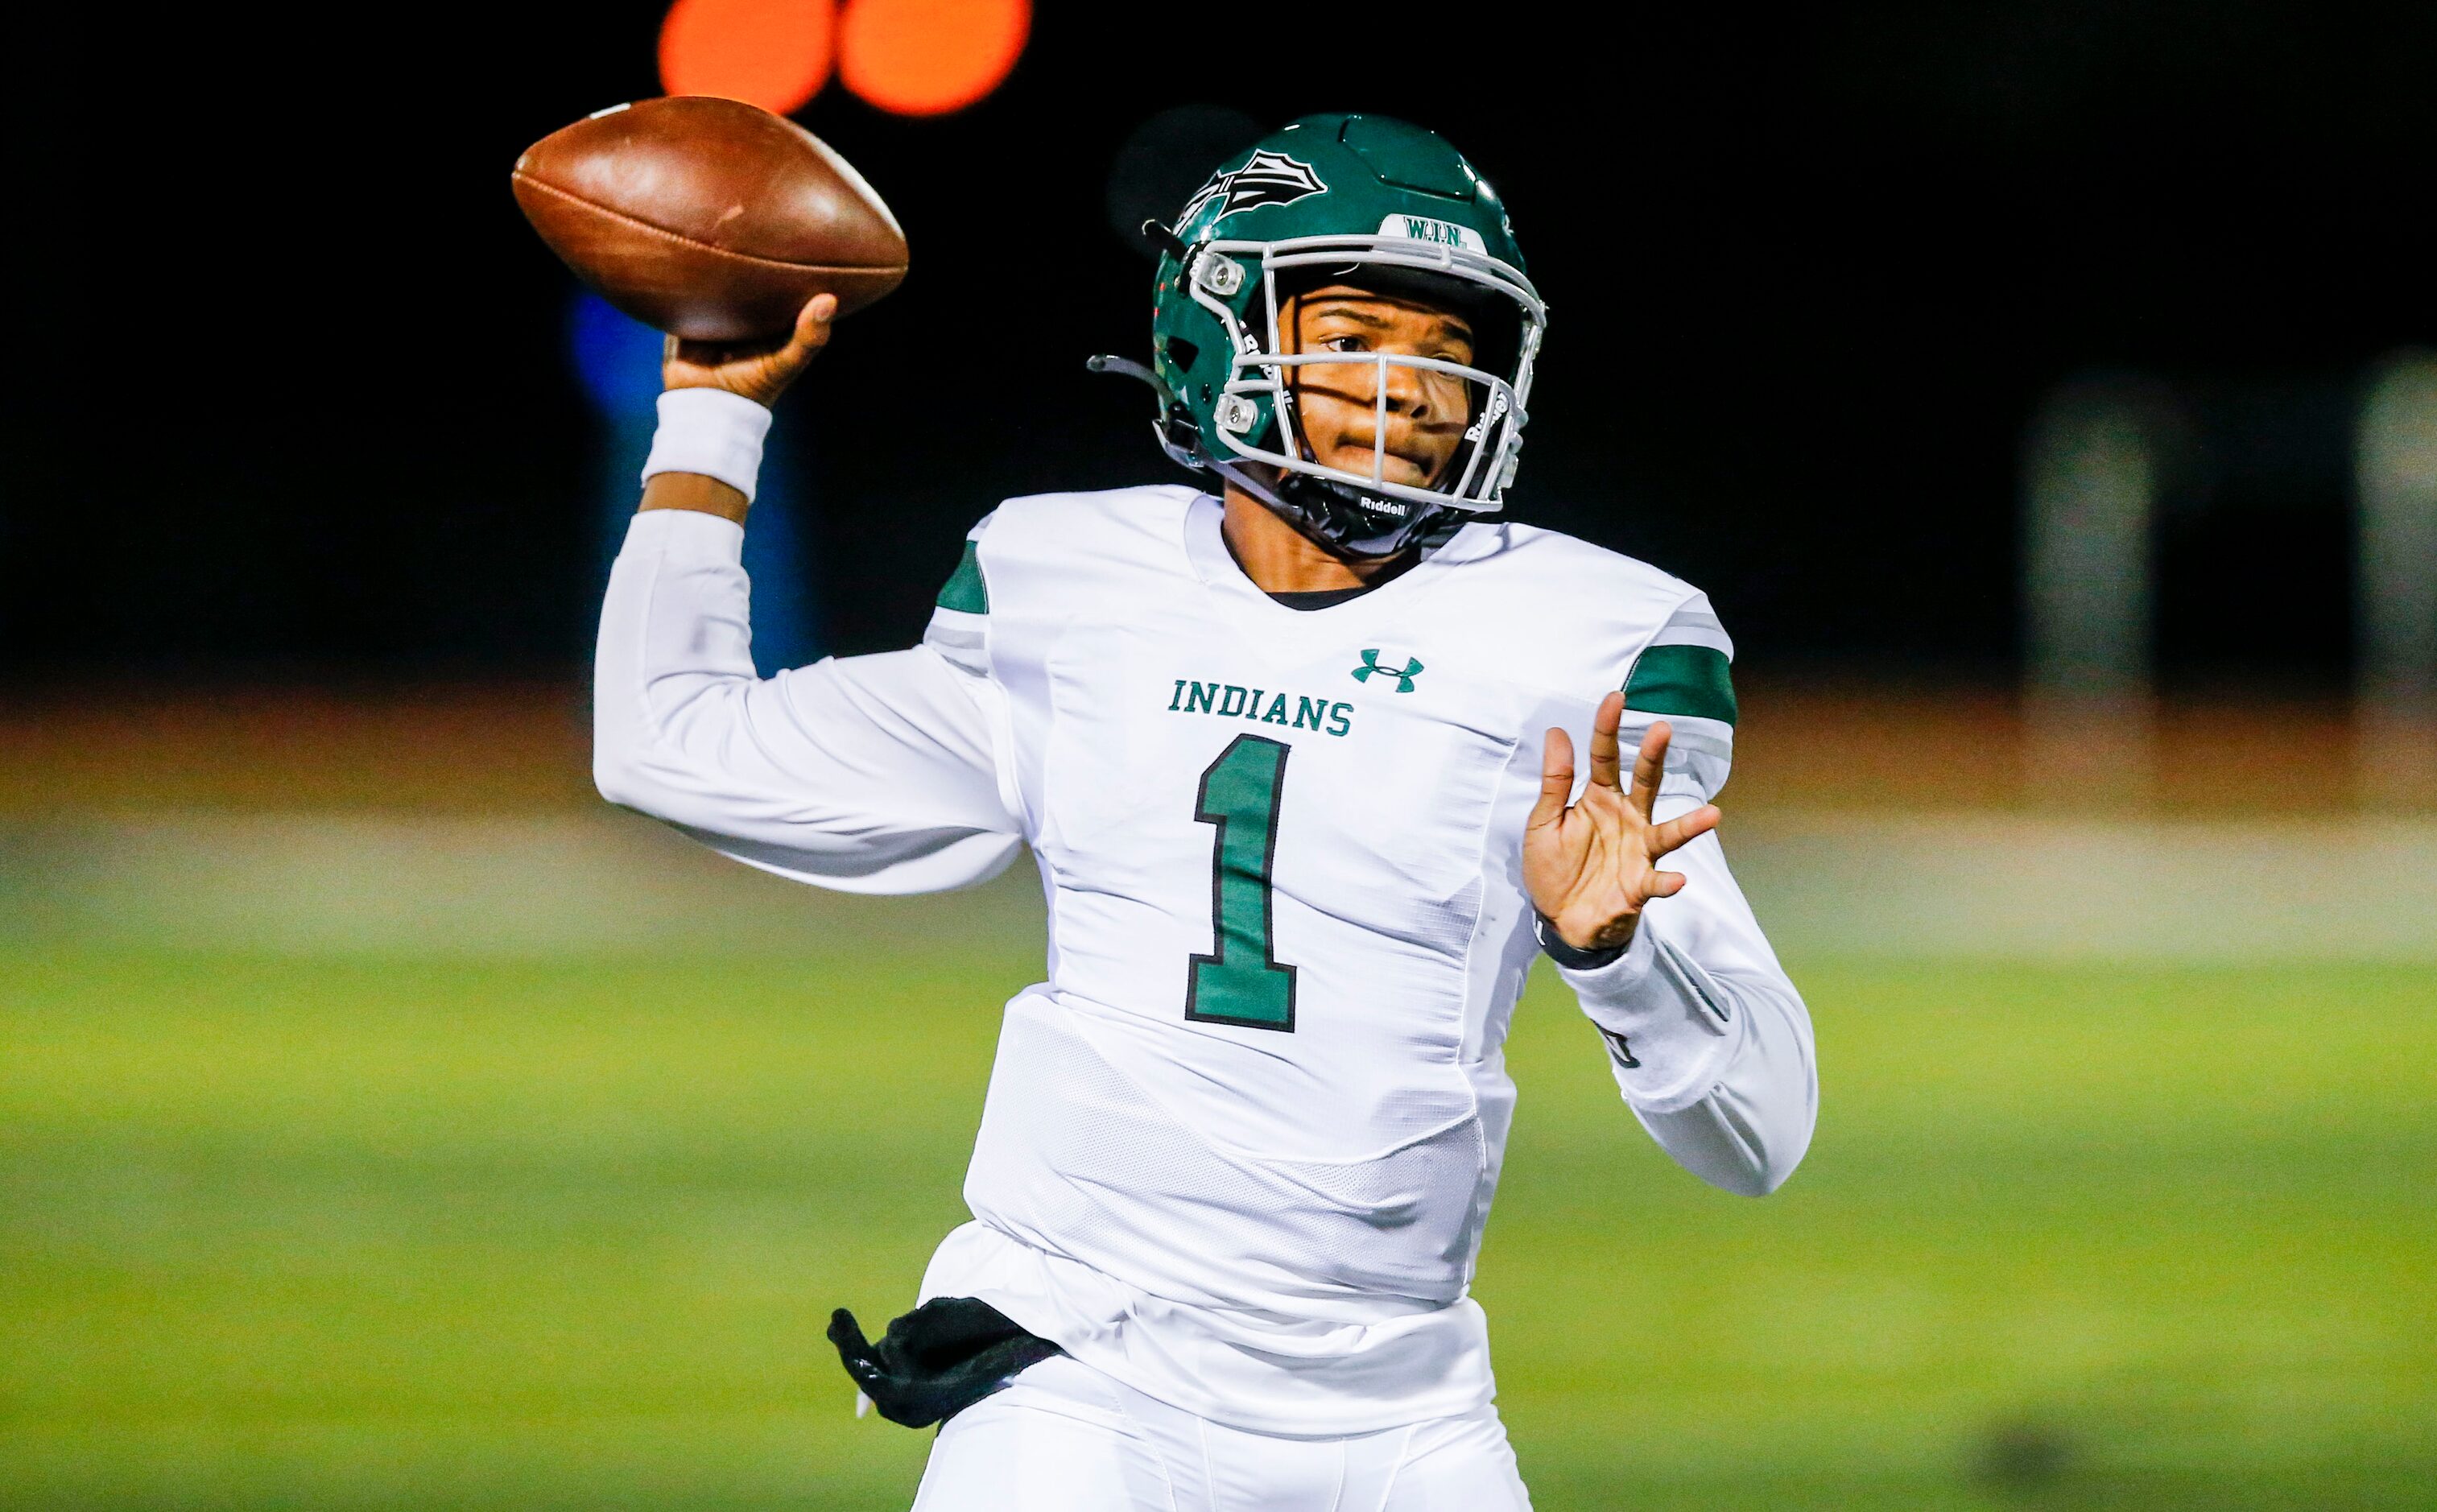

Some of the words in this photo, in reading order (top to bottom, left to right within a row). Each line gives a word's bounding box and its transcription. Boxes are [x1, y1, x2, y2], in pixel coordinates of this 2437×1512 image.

[1361, 496, 1406, 517] Riddell
[1167, 680, 1354, 737] INDIANS
[1185, 733, 1297, 1033] 1
